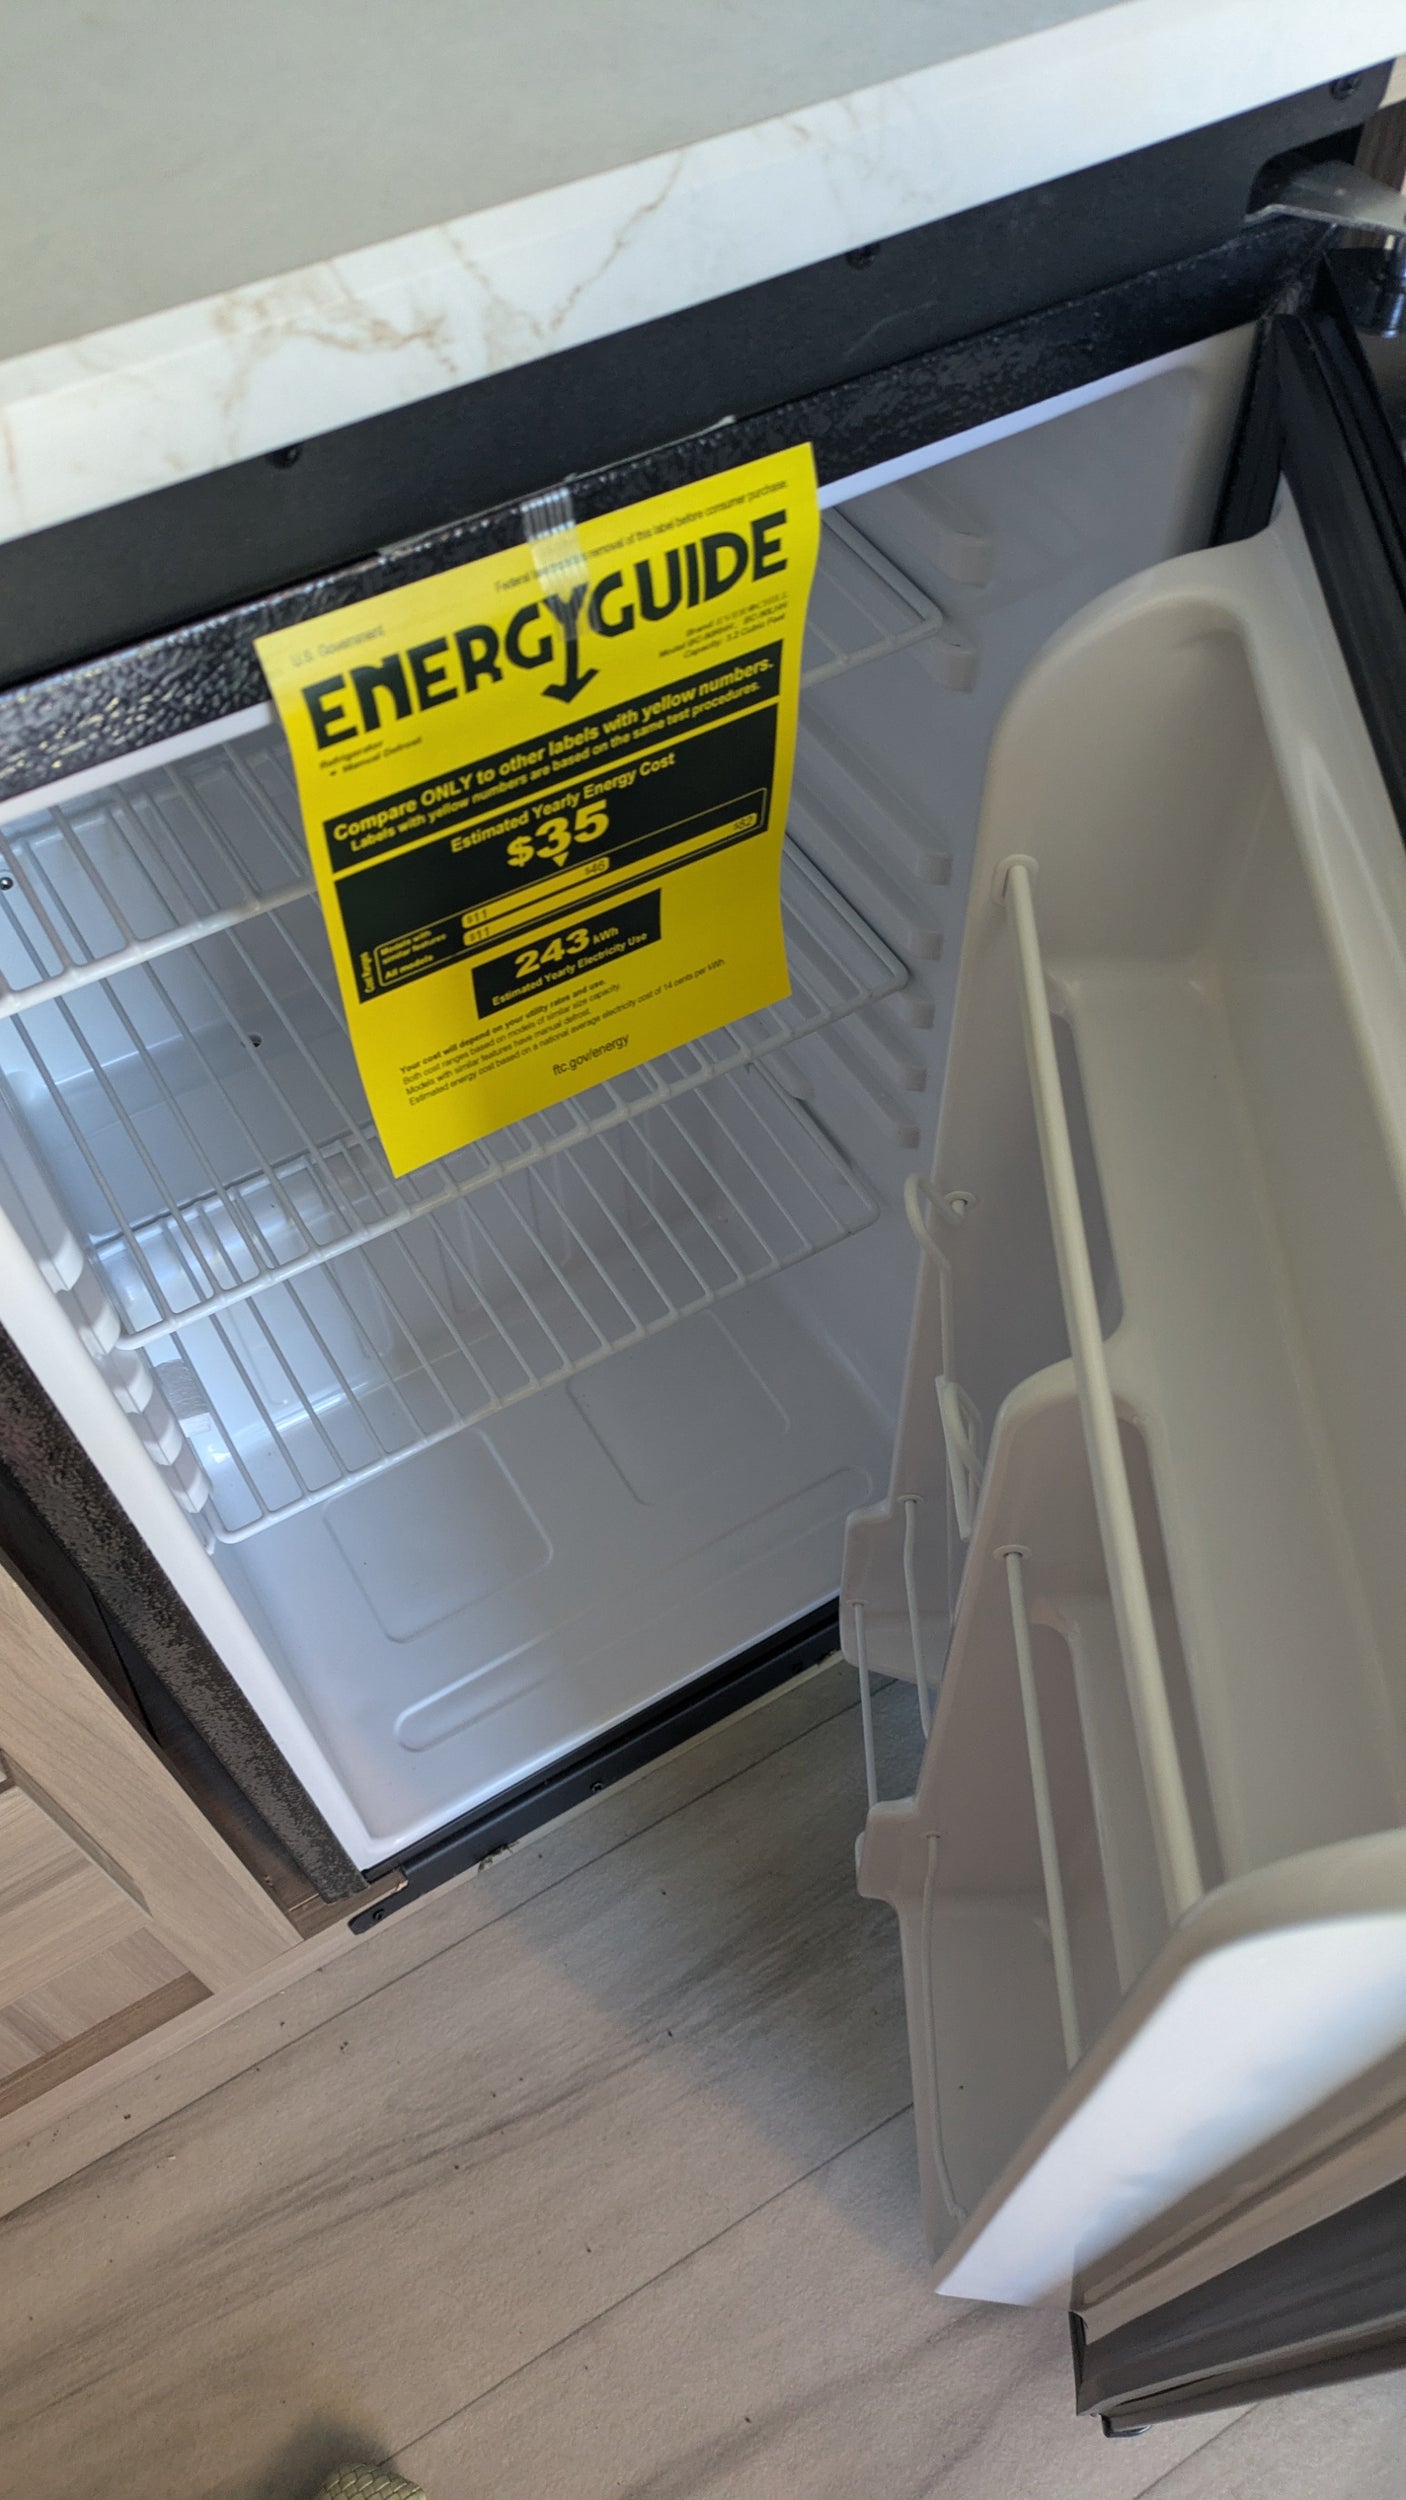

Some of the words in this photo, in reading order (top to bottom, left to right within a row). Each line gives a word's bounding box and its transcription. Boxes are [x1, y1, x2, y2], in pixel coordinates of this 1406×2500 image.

[495, 572, 530, 593] Federal
[588, 539, 624, 558] removal
[636, 529, 652, 541] this
[654, 521, 674, 535] label
[676, 510, 703, 526] before
[705, 496, 745, 516] consumer
[318, 625, 385, 658] Government
[319, 740, 384, 770] Refrigerator
[333, 798, 418, 841] Compare
[420, 773, 473, 806] ONLY
[476, 768, 496, 785] to
[499, 747, 546, 777] other
[548, 725, 600, 756] labels
[602, 709, 639, 734] with
[641, 687, 698, 723] yellow
[698, 657, 775, 696] numbers.
[342, 752, 382, 773] Manual
[384, 736, 422, 758] Defrost
[350, 824, 397, 852] Labels
[397, 811, 427, 833] with
[427, 798, 470, 824] yellow
[471, 772, 529, 804] numbers
[529, 764, 550, 781] are
[551, 747, 591, 772] based
[592, 741, 609, 755] on
[610, 731, 631, 748] the
[632, 719, 665, 740] same
[666, 709, 690, 726] test
[691, 681, 761, 719] procedures.
[451, 808, 530, 853] Estimated
[531, 791, 581, 819] Yearly
[583, 769, 637, 799] Energy
[639, 752, 676, 777] Cost
[507, 799, 610, 867] $35
[466, 909, 487, 924] $11
[469, 927, 490, 942] $11
[514, 928, 590, 978] 243
[592, 926, 620, 945] kWh
[384, 967, 398, 980] All
[399, 954, 434, 973] models
[492, 977, 543, 1006] Estimated
[544, 963, 576, 982] Yearly
[577, 941, 627, 968] Electricity
[627, 932, 648, 946] Use
[400, 1061, 420, 1075] Your
[422, 1051, 441, 1065] cost
[442, 1043, 458, 1055] will
[459, 1029, 490, 1049] depend
[491, 1024, 503, 1033] on
[504, 1015, 523, 1029] your
[525, 1004, 548, 1018] utility
[550, 994, 570, 1008] rates
[572, 985, 588, 998] and
[402, 1072, 423, 1085] Both
[423, 1063, 440, 1076] cost
[441, 1052, 469, 1067] ranges
[470, 1039, 495, 1055] based
[507, 1021, 535, 1039] models
[546, 1005, 570, 1021] similar
[573, 997, 587, 1009] size
[405, 1078, 435, 1095] Models
[436, 1070, 453, 1082] with
[454, 1058, 480, 1074] similar
[480, 1044, 512, 1062] features
[513, 1035, 533, 1048] have
[534, 1021, 562, 1037] manual
[409, 1083, 449, 1106] Estimated
[450, 1070, 477, 1088] energy
[478, 1062, 495, 1075] cost
[496, 1051, 520, 1067] based
[539, 1029, 569, 1047] national
[570, 1016, 601, 1034] average
[601, 1000, 636, 1019] electricity
[637, 991, 653, 1004] cost
[673, 973, 694, 987] cents
[694, 967, 707, 980] per
[552, 1034, 630, 1076] ftc.gov/energy
